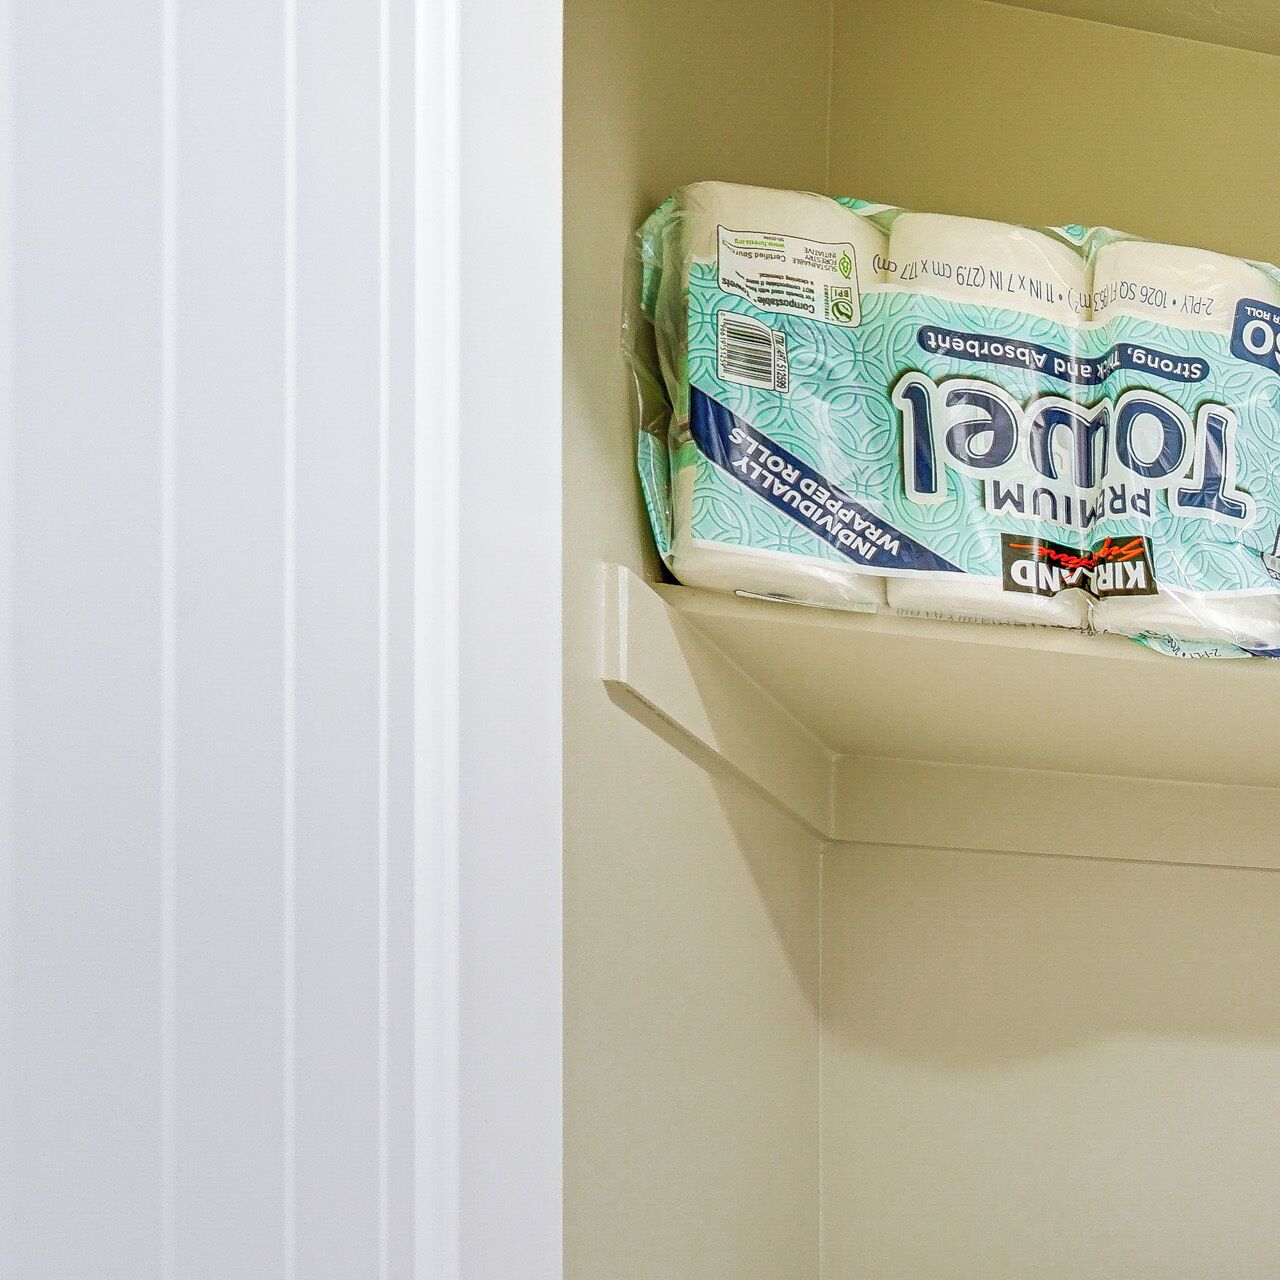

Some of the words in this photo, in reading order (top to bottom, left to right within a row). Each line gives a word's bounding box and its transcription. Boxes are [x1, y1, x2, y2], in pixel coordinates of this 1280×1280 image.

[932, 260, 952, 277] cm
[956, 265, 986, 288] (27.9
[990, 269, 1004, 291] IN
[834, 289, 850, 299] BPI
[1007, 273, 1016, 293] 7
[1029, 277, 1044, 300] IN
[1119, 280, 1138, 302] SQ
[1139, 286, 1168, 309] 1026
[1180, 294, 1215, 316] 2-PLY
[1244, 305, 1271, 321] ROLL
[926, 329, 1048, 368] Absorbent
[1054, 355, 1092, 378] and
[1127, 346, 1203, 380] Strong,
[728, 426, 802, 484] ROLLS
[899, 380, 1248, 519] Towel
[732, 454, 878, 561] INDIVIDUALLY
[799, 468, 900, 557] WRAPPED
[992, 479, 1152, 527] PREMIUM
